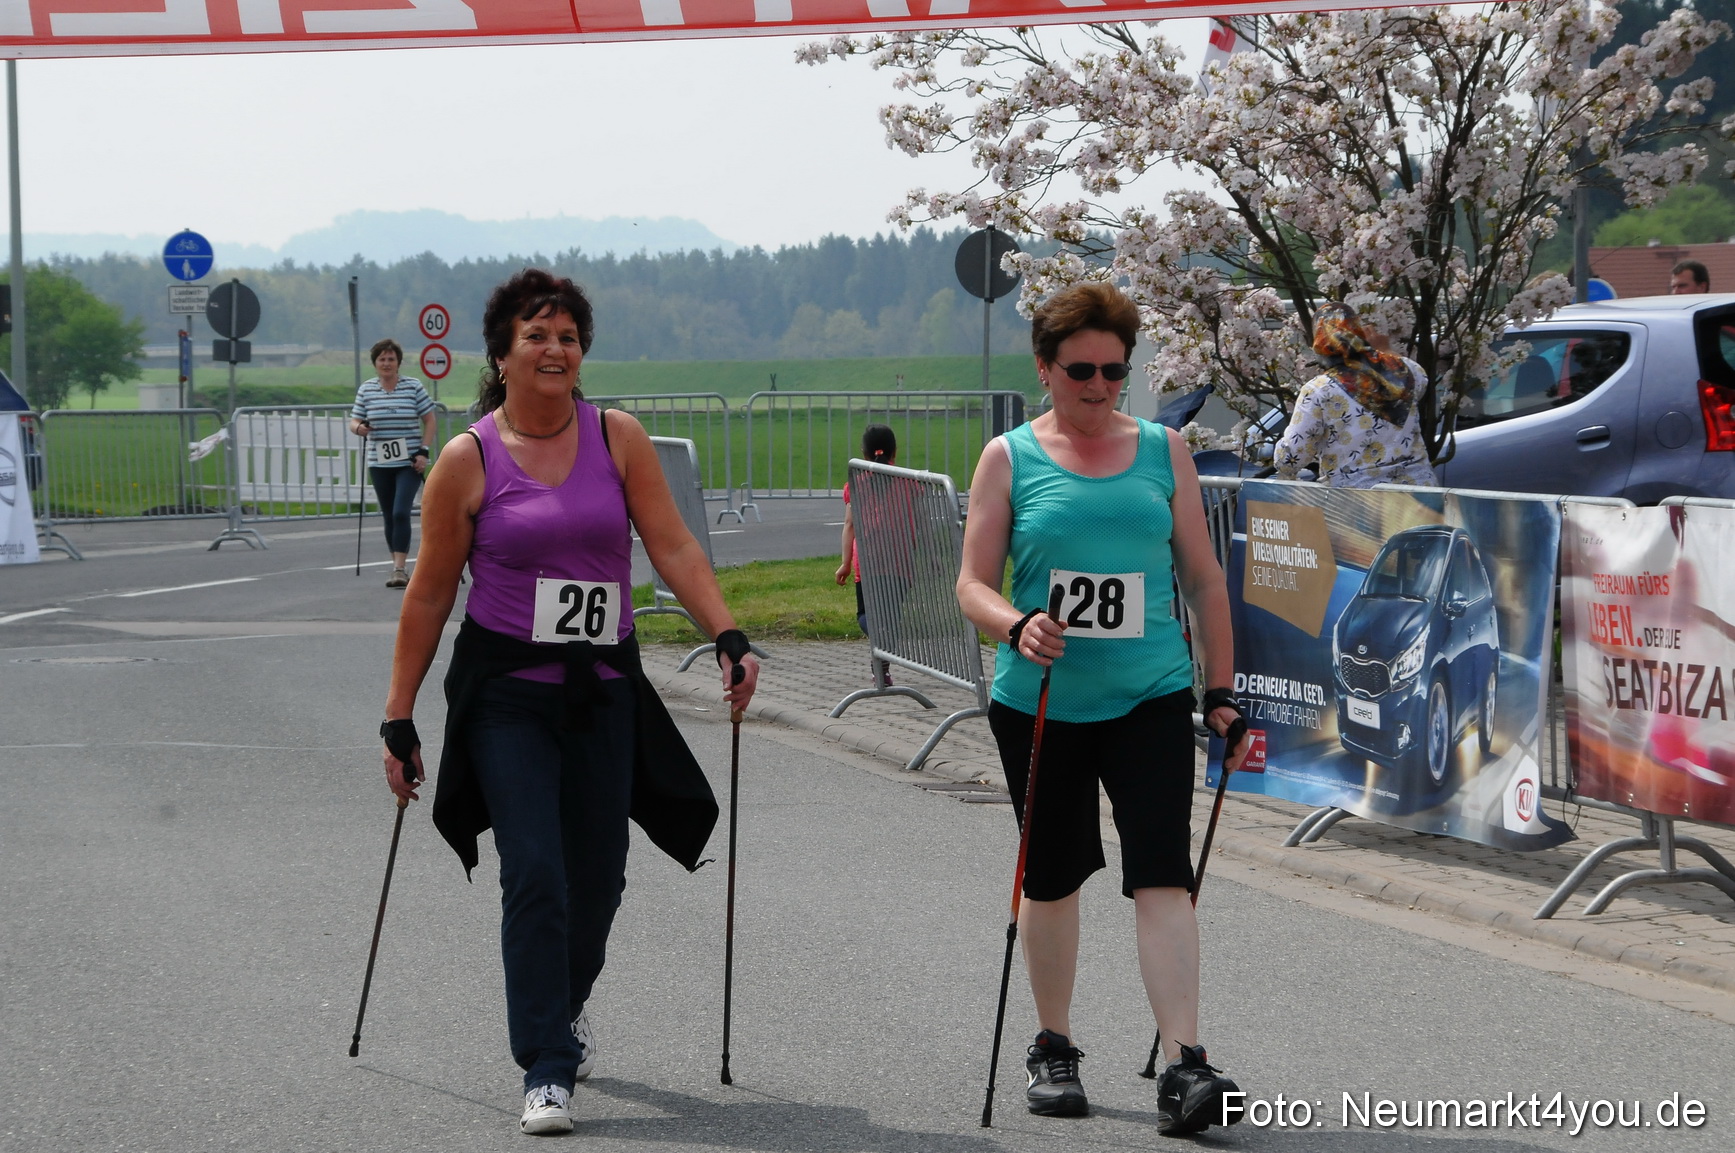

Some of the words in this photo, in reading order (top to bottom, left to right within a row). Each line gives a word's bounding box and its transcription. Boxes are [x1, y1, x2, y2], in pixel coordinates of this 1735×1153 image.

[426, 314, 443, 330] 60
[382, 441, 401, 460] 30
[1265, 518, 1290, 541] SEINER
[1274, 543, 1318, 569] QUALITÄTEN:
[1593, 573, 1637, 596] FREIRAUM
[1637, 571, 1670, 596] FÜRS
[555, 584, 608, 639] 26
[1067, 576, 1126, 630] 28
[1587, 602, 1643, 648] LEBEN.
[1644, 627, 1664, 648] DER
[1233, 672, 1264, 695] DER
[1265, 676, 1288, 699] NEUE
[1289, 680, 1303, 701] KIA
[1303, 683, 1326, 706] CEE'D.
[1603, 655, 1658, 711] SEAT
[1658, 661, 1728, 721] BIZA
[1267, 701, 1293, 724] PROBE
